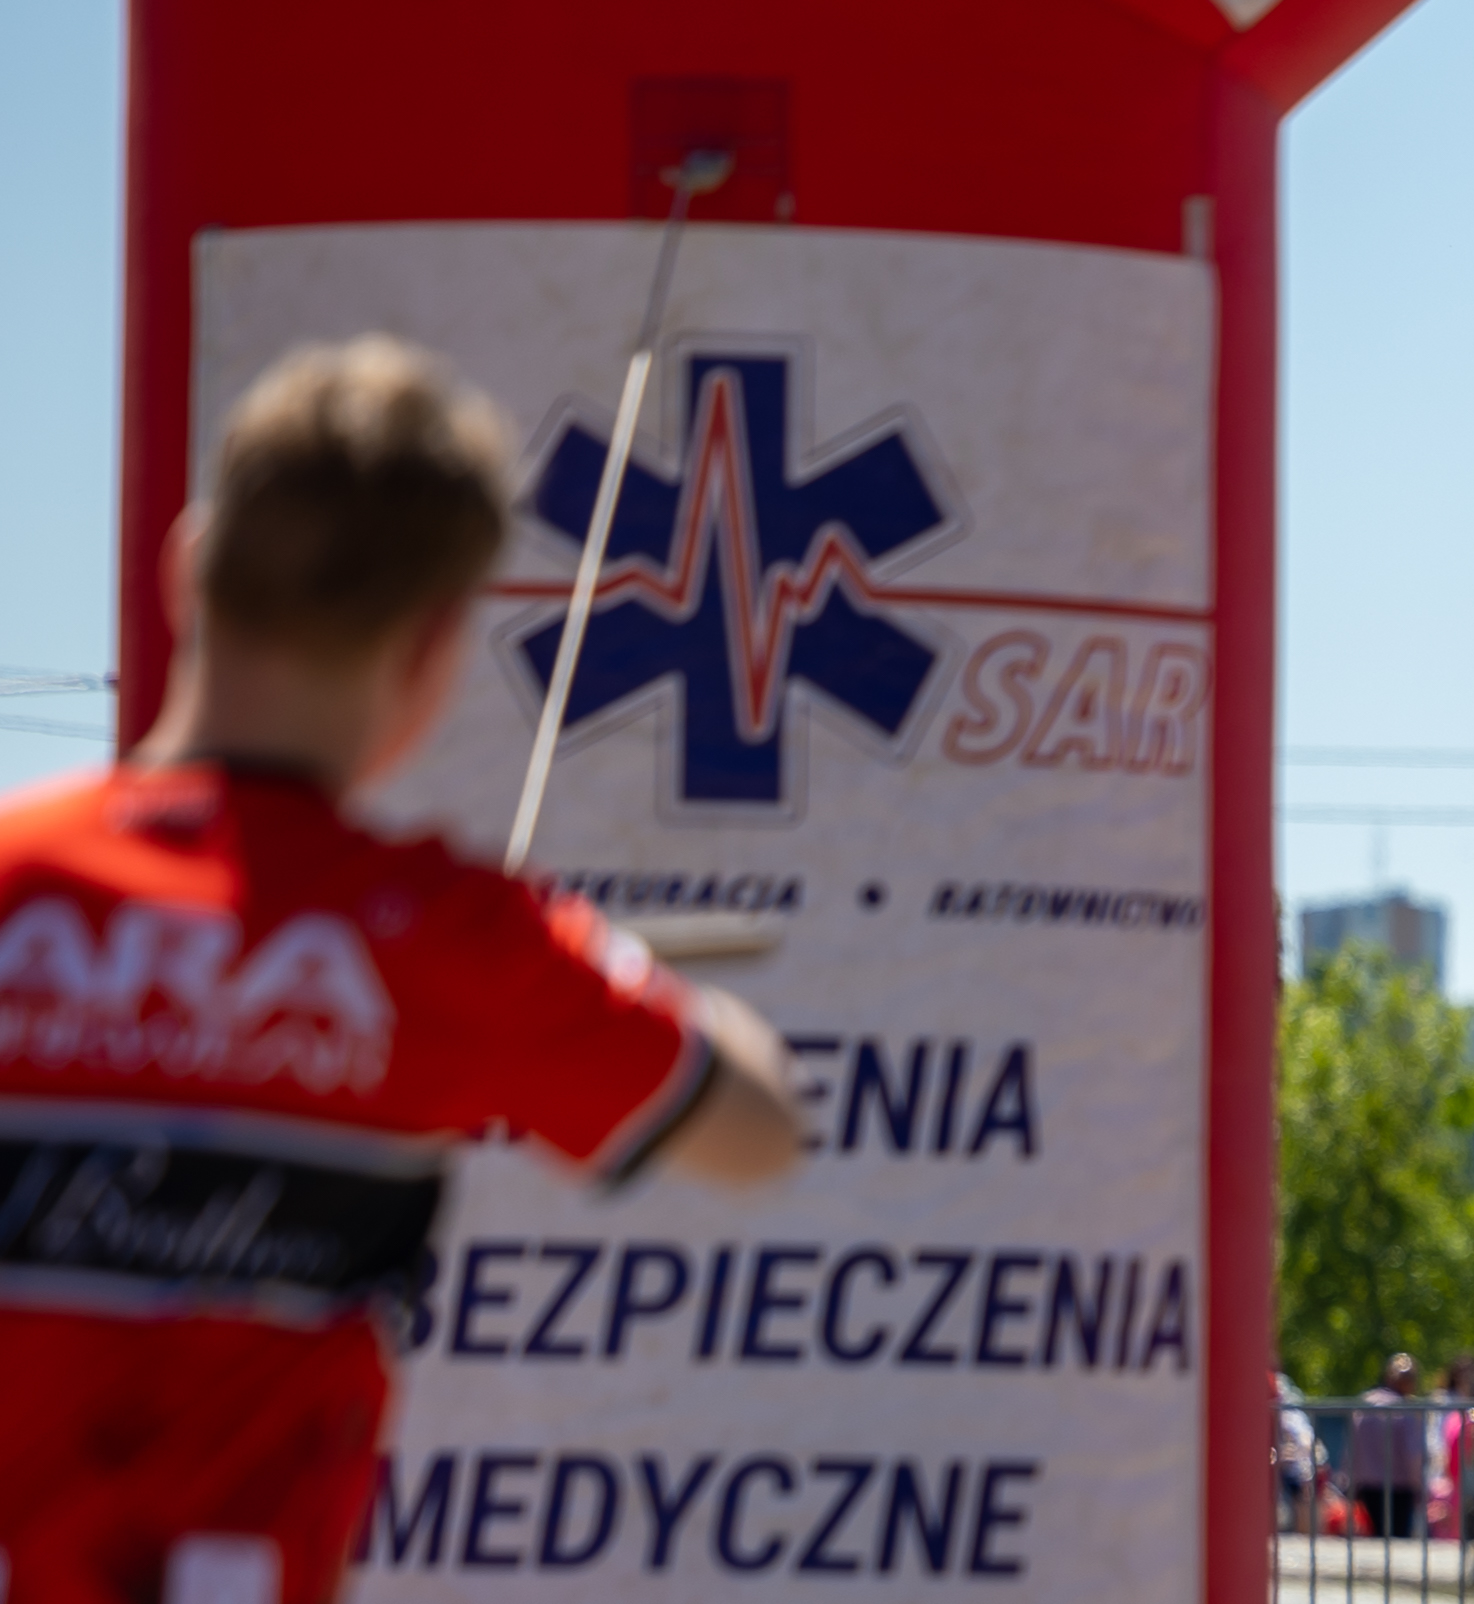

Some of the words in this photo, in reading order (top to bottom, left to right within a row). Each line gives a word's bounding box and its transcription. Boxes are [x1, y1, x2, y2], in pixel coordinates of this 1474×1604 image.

[942, 628, 1211, 775] SAR
[402, 1238, 1193, 1376] BEZPIECZENIA
[350, 1450, 1041, 1582] MEDYCZNE
